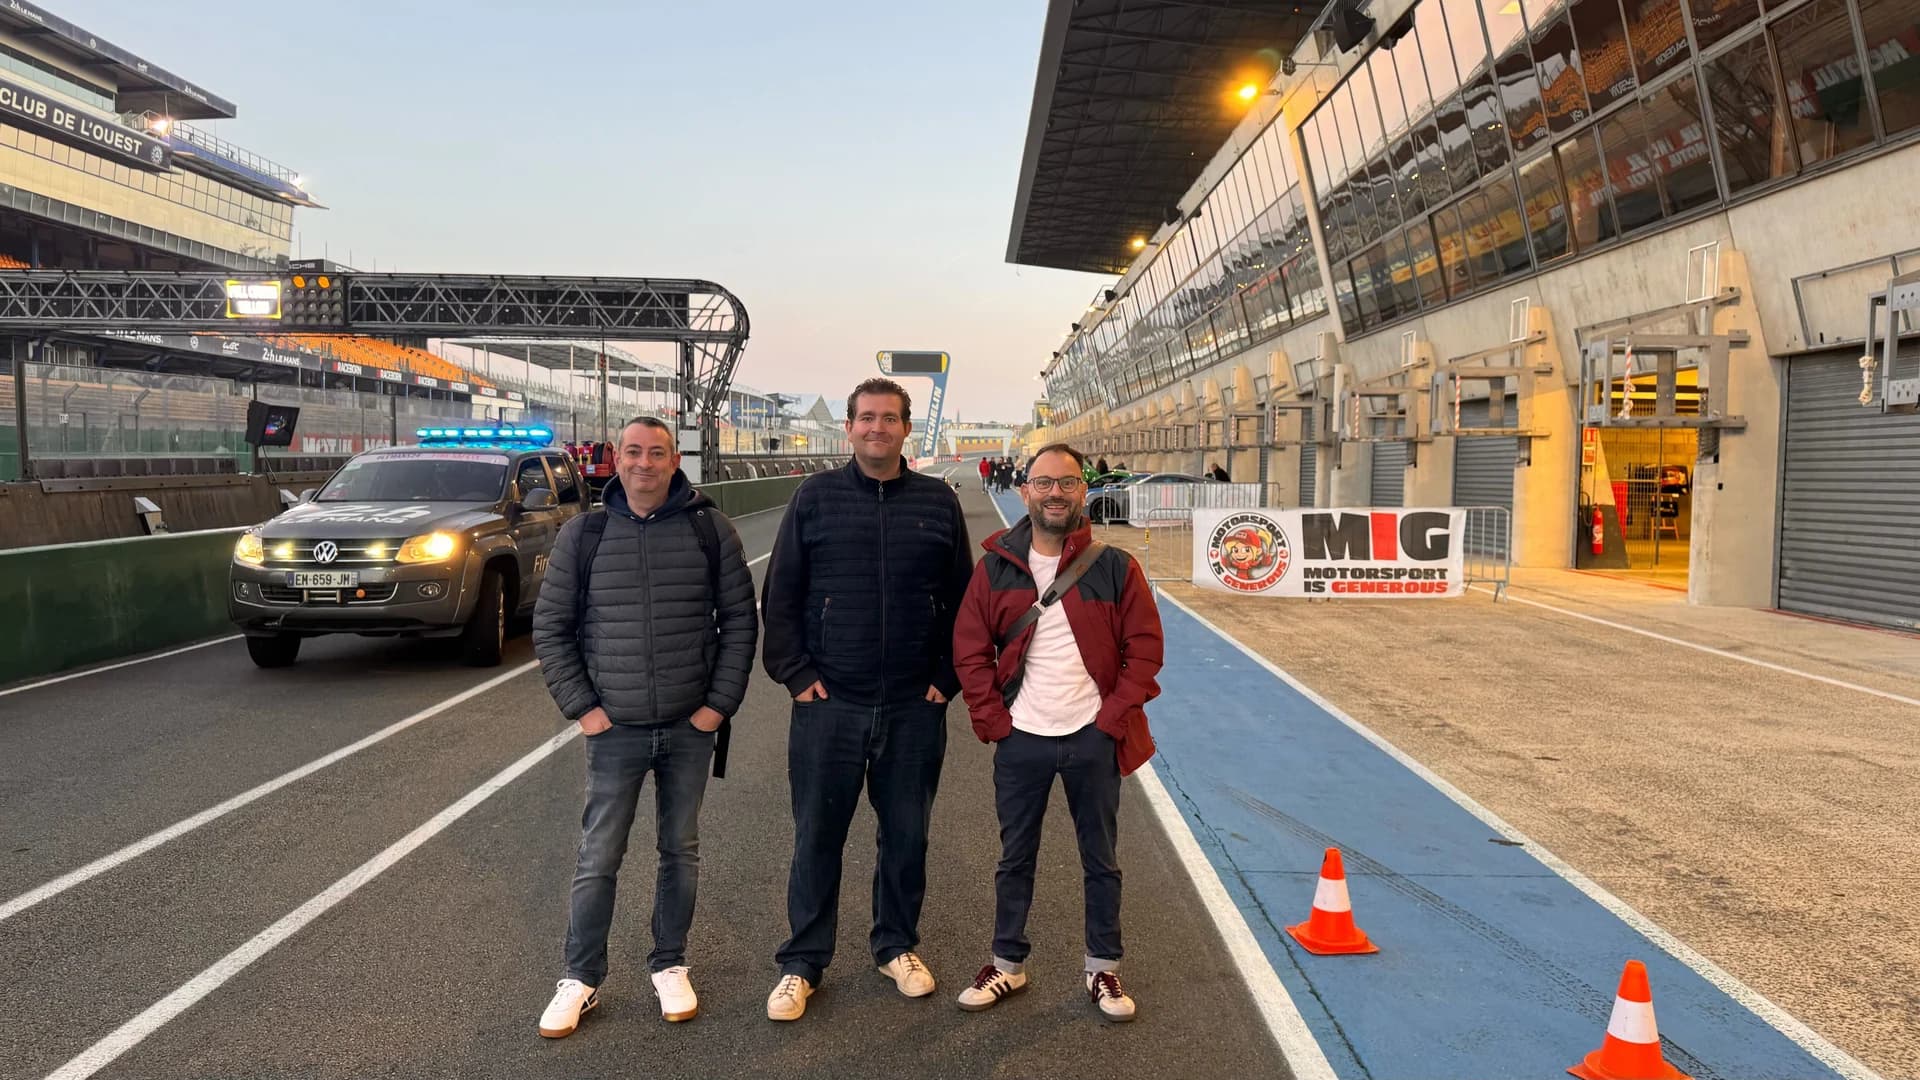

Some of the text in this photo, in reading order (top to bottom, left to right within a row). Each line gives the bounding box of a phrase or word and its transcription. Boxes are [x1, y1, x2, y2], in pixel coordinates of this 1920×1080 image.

[0, 87, 143, 155] CLUB DE L'OUEST
[924, 385, 942, 452] MICHELIN
[320, 516, 408, 524] MANS
[1206, 515, 1286, 549] MOTORSPORT
[1302, 512, 1451, 561] MIG
[1212, 560, 1287, 591] IS GENEROUS
[1303, 567, 1448, 580] MOTORSPORT
[1303, 581, 1448, 594] IS GENEROUS
